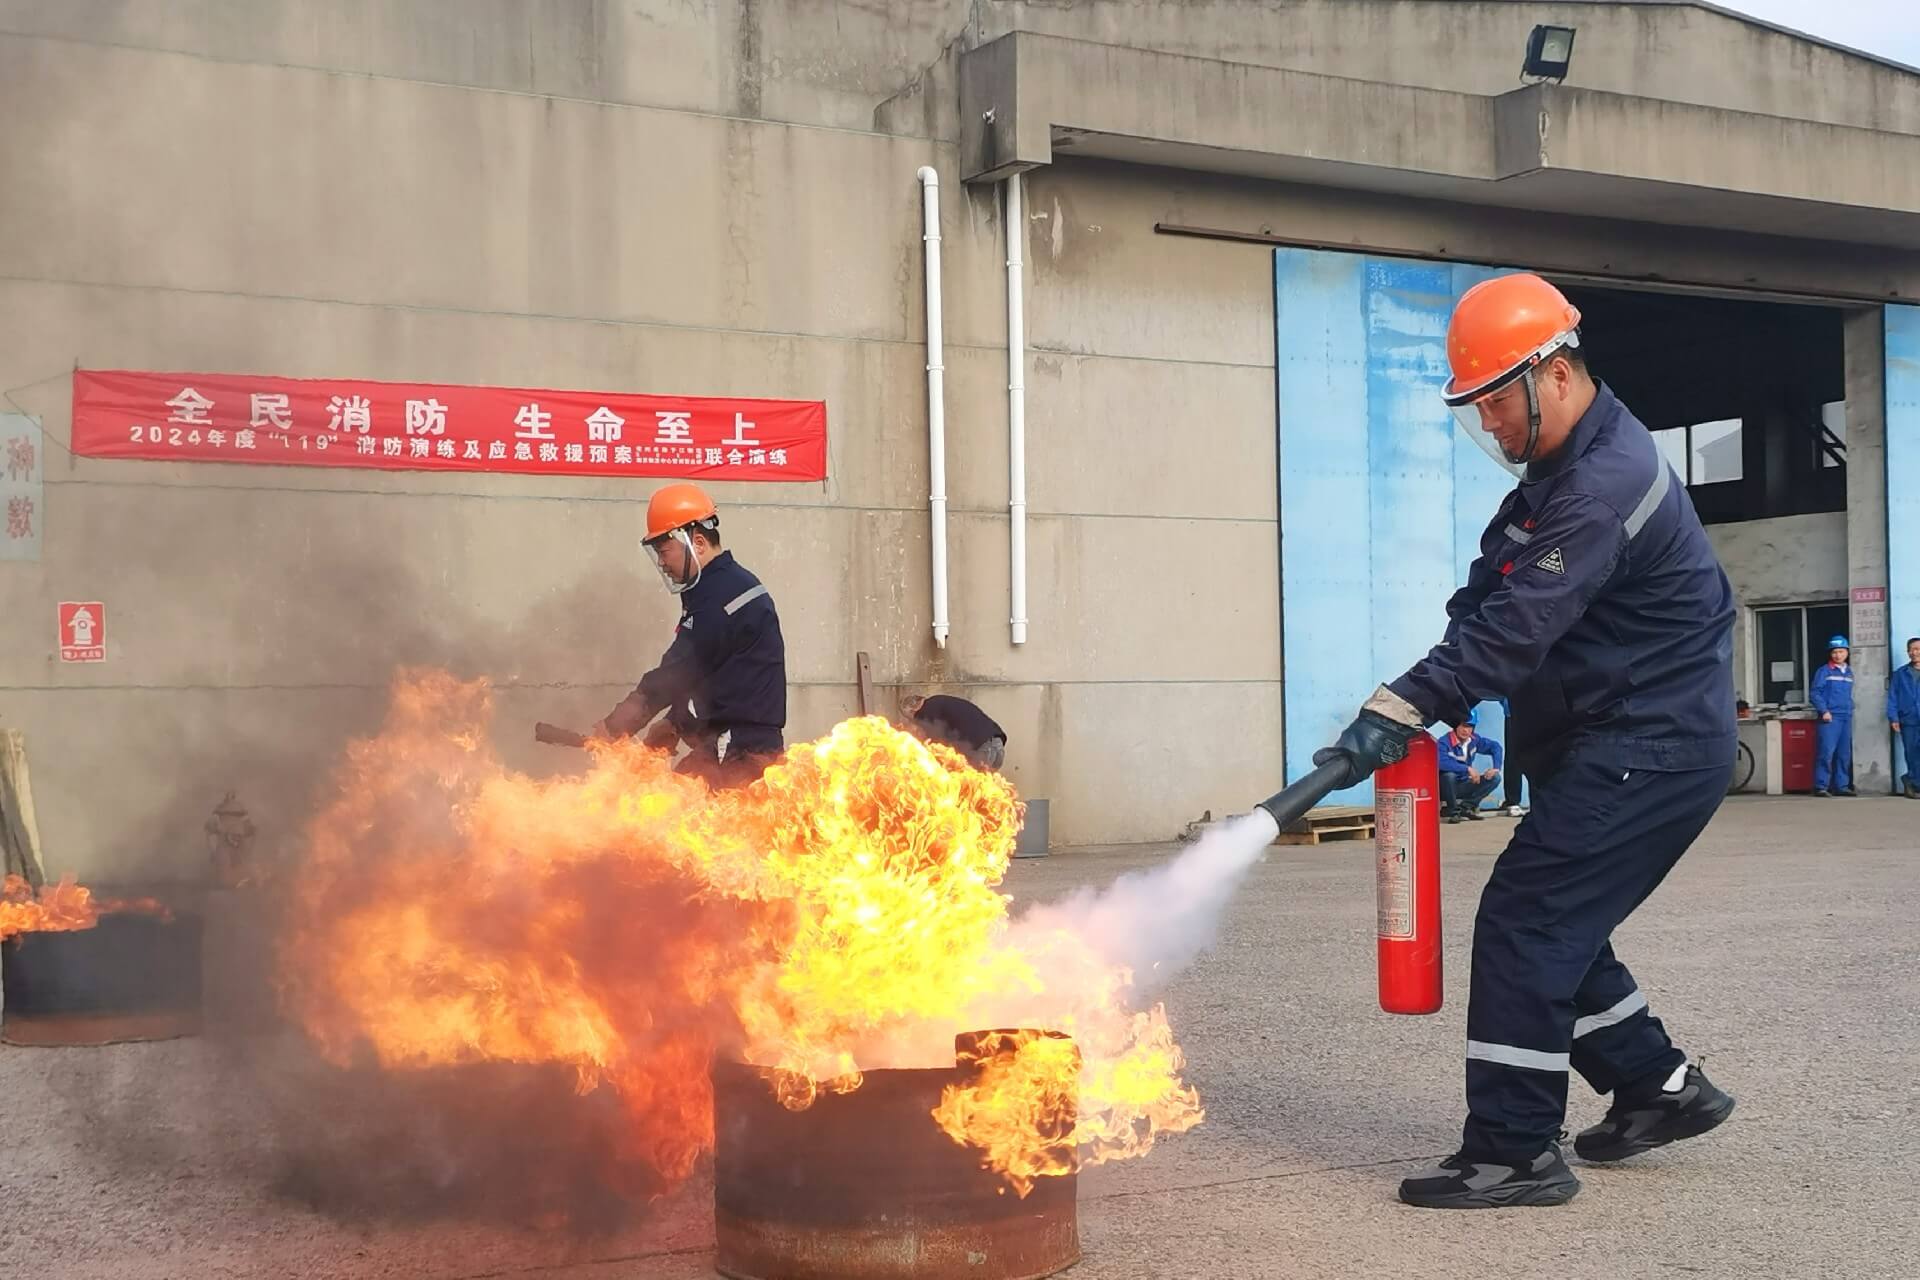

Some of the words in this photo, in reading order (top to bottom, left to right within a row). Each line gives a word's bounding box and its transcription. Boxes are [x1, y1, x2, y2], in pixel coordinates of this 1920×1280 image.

[165, 387, 449, 435] 全民消防
[513, 403, 760, 447] 生命至上
[704, 447, 788, 467] 联合演练
